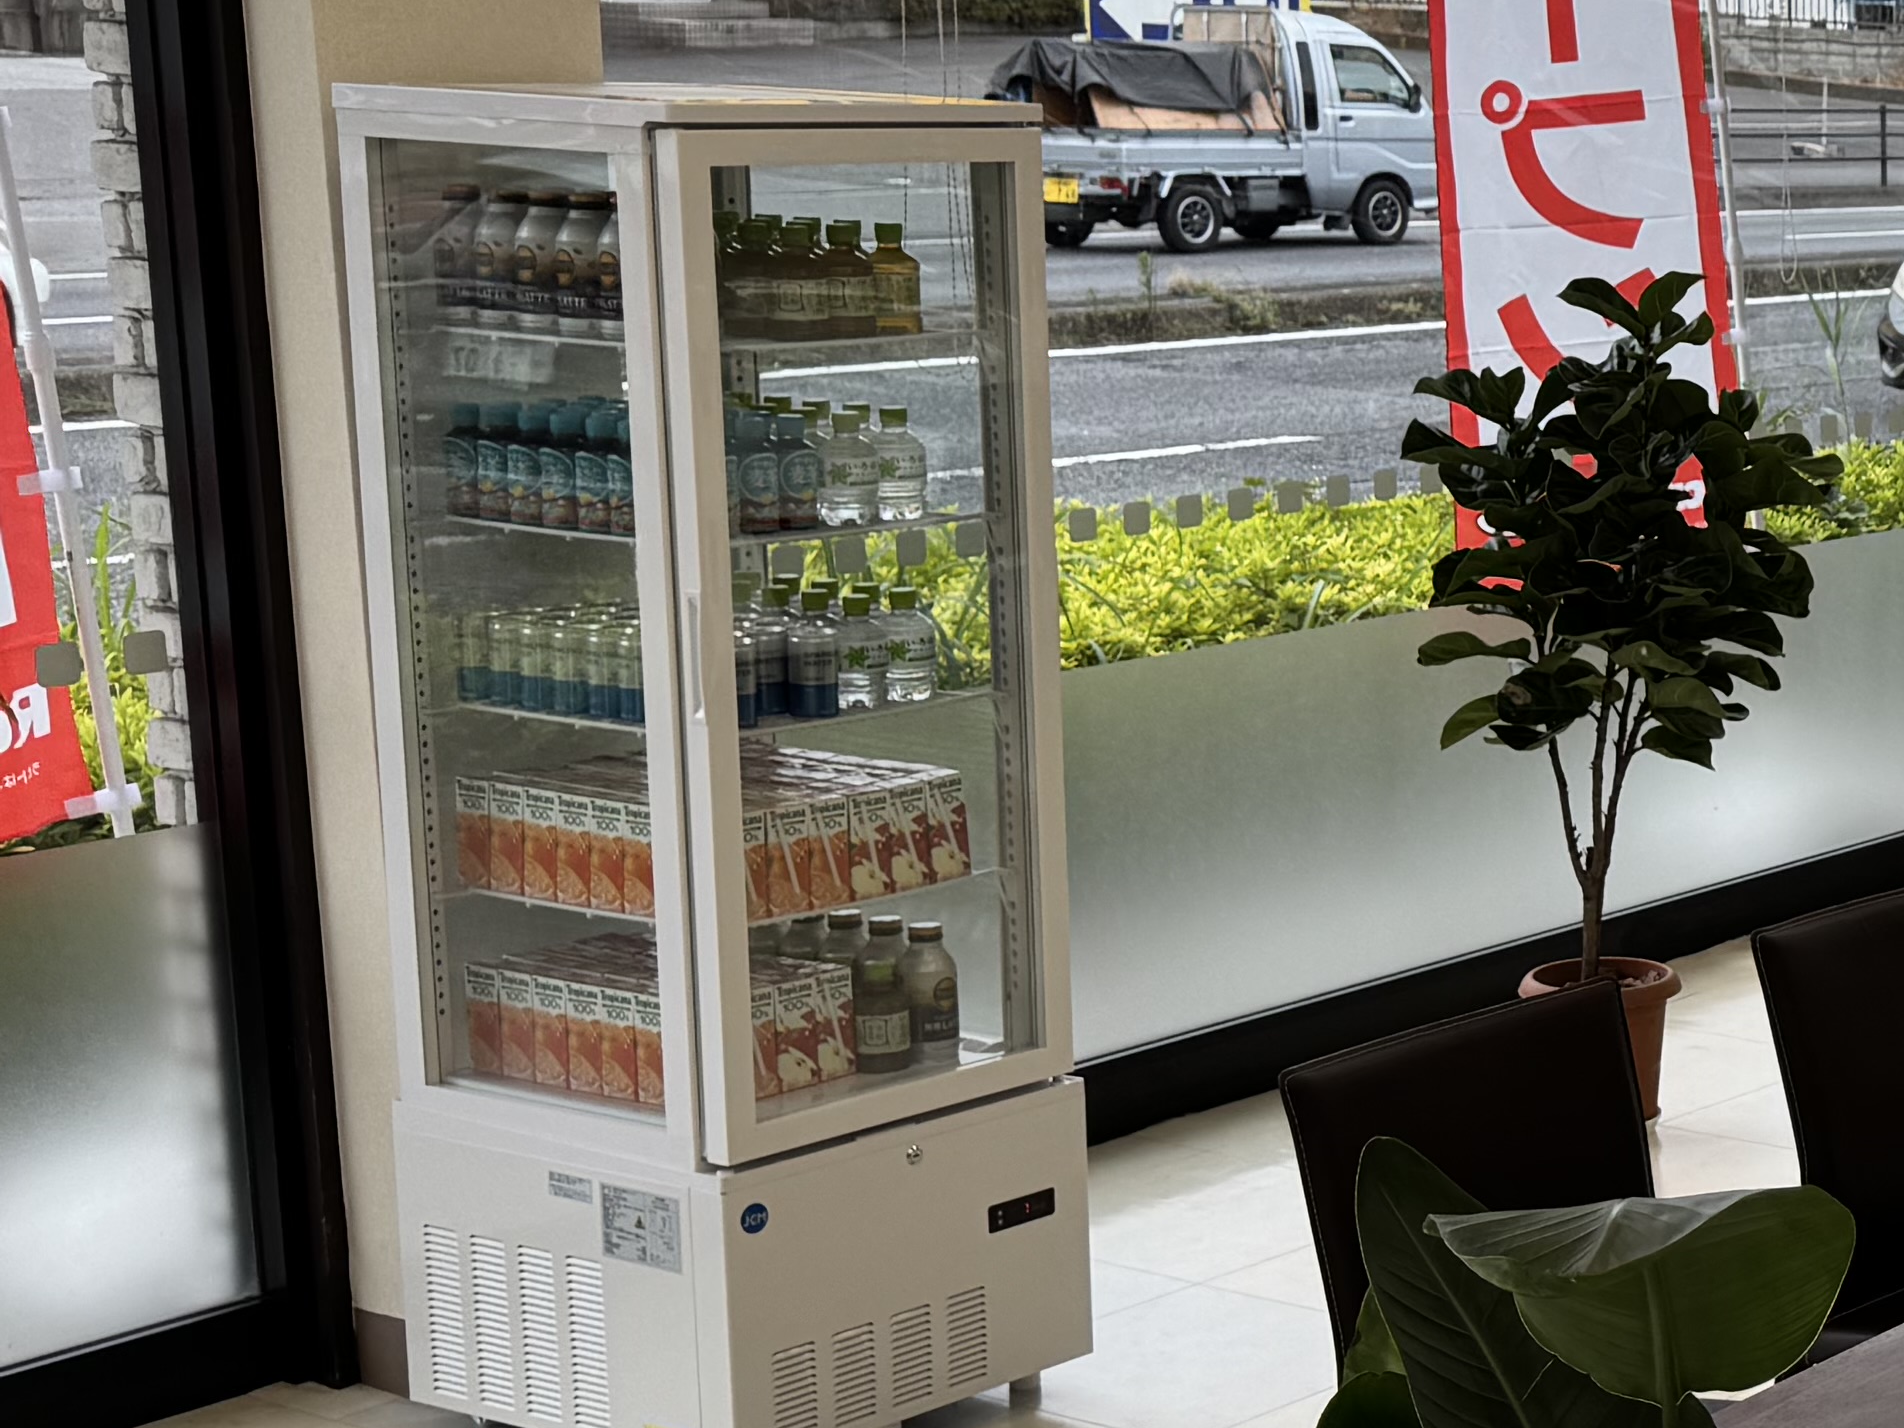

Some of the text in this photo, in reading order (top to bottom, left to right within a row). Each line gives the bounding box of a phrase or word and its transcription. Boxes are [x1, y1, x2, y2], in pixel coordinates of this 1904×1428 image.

[491, 784, 521, 799] Tropicana
[525, 789, 555, 805] Tropicana
[557, 795, 588, 811] Tropicana
[590, 800, 621, 816] Tropicana
[499, 971, 529, 987] Tropicana
[534, 978, 563, 994] Tropicana
[566, 984, 598, 1000] Tropicana
[600, 990, 632, 1005] Tropicana
[776, 981, 812, 998] Tropicana
[742, 1211, 767, 1228] JCM
